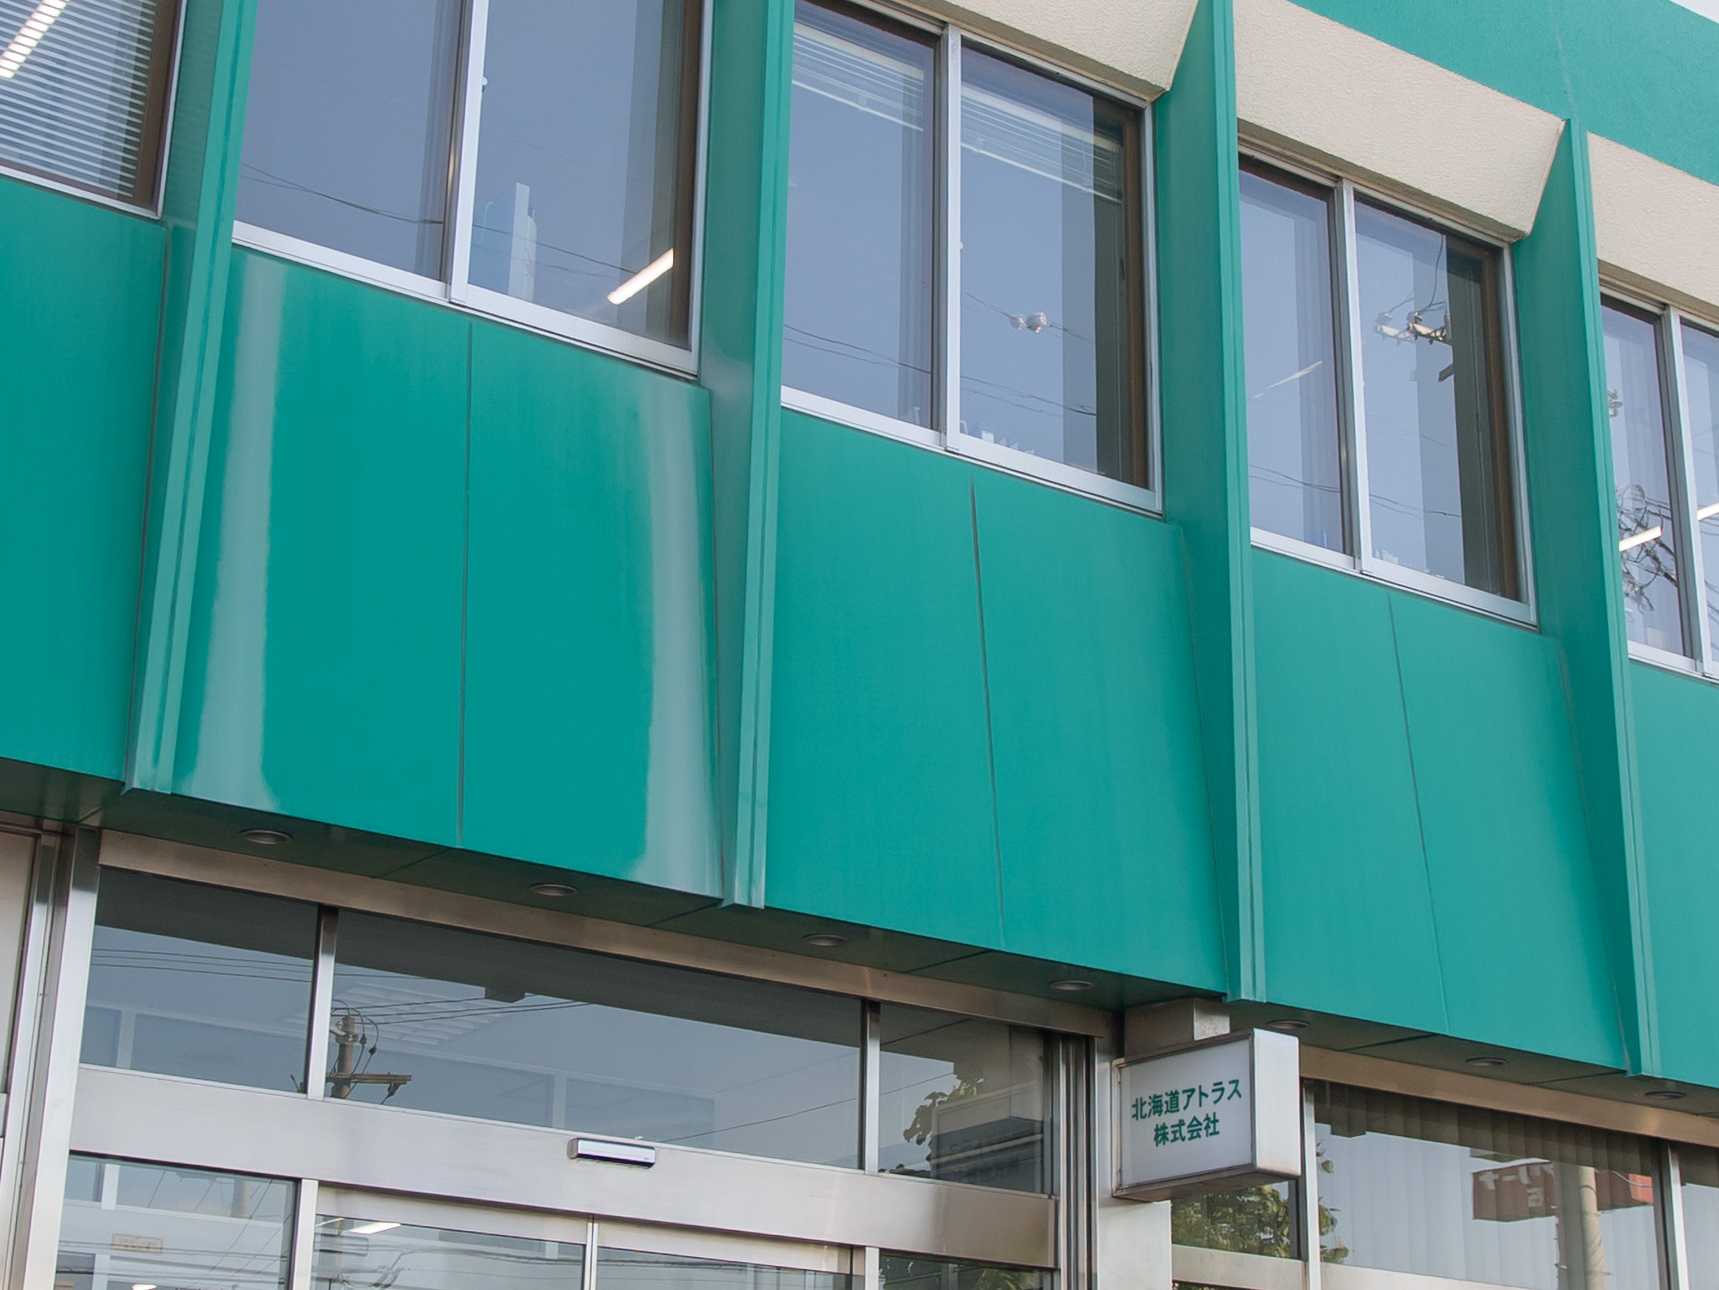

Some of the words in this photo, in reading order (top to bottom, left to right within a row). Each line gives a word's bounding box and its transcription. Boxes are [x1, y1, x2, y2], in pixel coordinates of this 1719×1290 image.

[1131, 1078, 1242, 1121] 北海道アトラス
[1153, 1112, 1220, 1147] 株式会社
